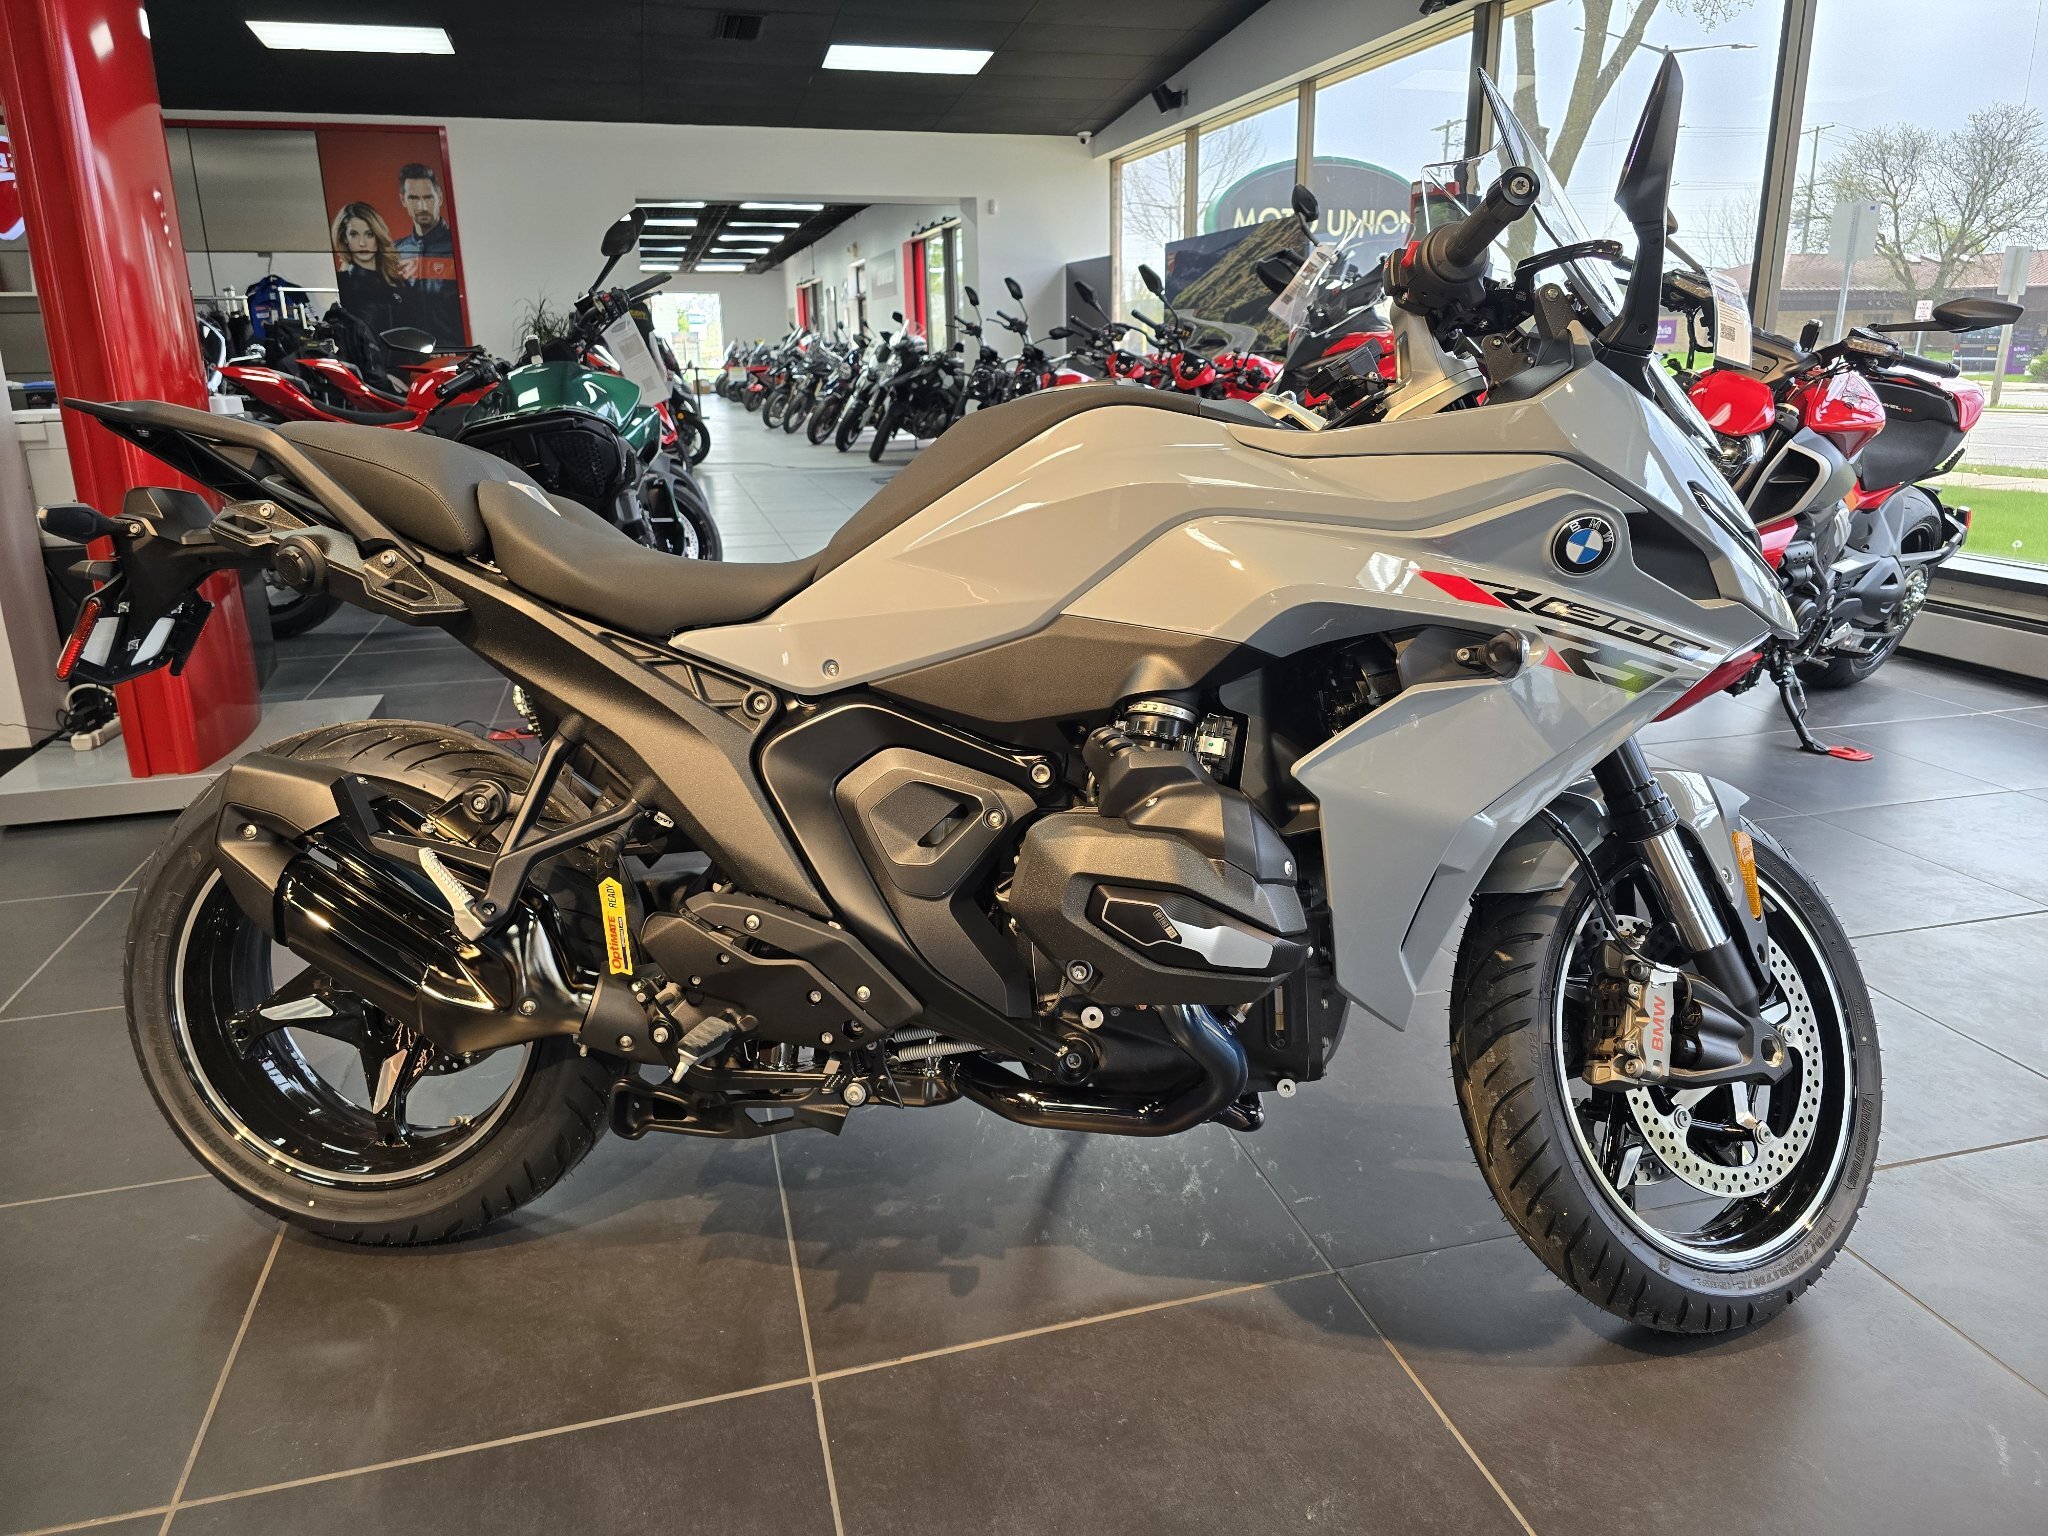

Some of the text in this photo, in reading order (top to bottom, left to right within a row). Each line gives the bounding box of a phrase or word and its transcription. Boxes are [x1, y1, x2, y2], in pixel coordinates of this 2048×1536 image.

[1569, 518, 1614, 543] BMW
[606, 884, 617, 908] READY
[1651, 996, 1666, 1051] BMW
[1848, 1097, 1874, 1188] BRIDGESTONE
